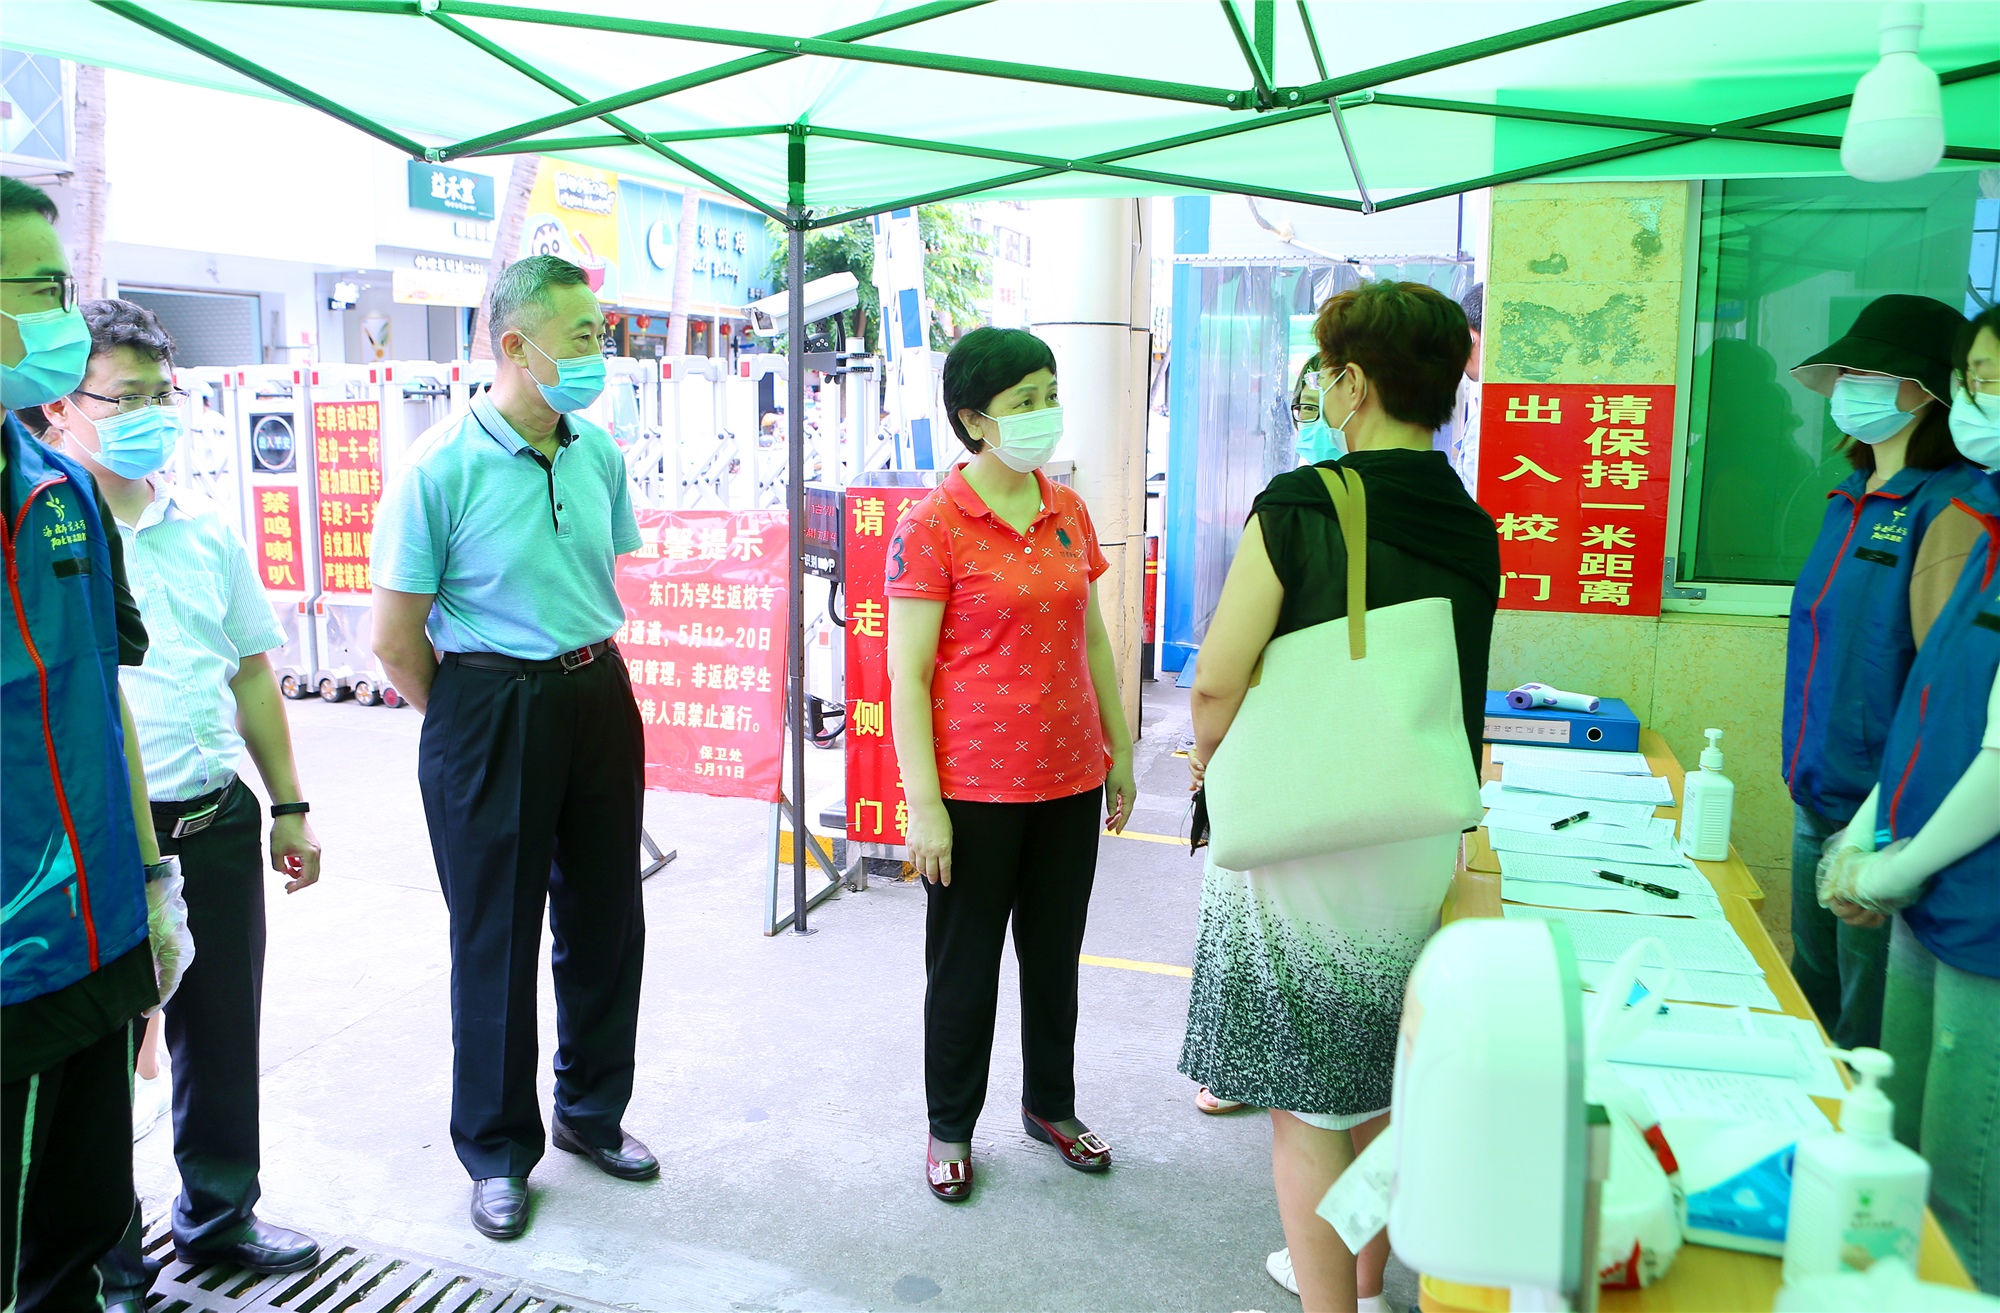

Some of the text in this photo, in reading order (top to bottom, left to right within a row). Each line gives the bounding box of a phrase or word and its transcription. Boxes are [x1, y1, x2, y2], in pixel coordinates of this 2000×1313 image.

[316, 404, 378, 432] 车牌自动识别
[317, 436, 380, 464] 进出一车一杆
[319, 468, 381, 496] 请勿跟随前车
[1496, 395, 1562, 601] 出入校门
[1577, 395, 1652, 606] 请保持一米距离
[261, 491, 296, 586] 禁鸣喇叭
[630, 527, 763, 561] 温馨提示
[887, 536, 905, 582] 3
[649, 581, 775, 612] 东门为学生返校专
[624, 658, 772, 693] 闭管理，非返校学生
[699, 745, 743, 763] 保卫处
[694, 762, 745, 779] 5月11日
